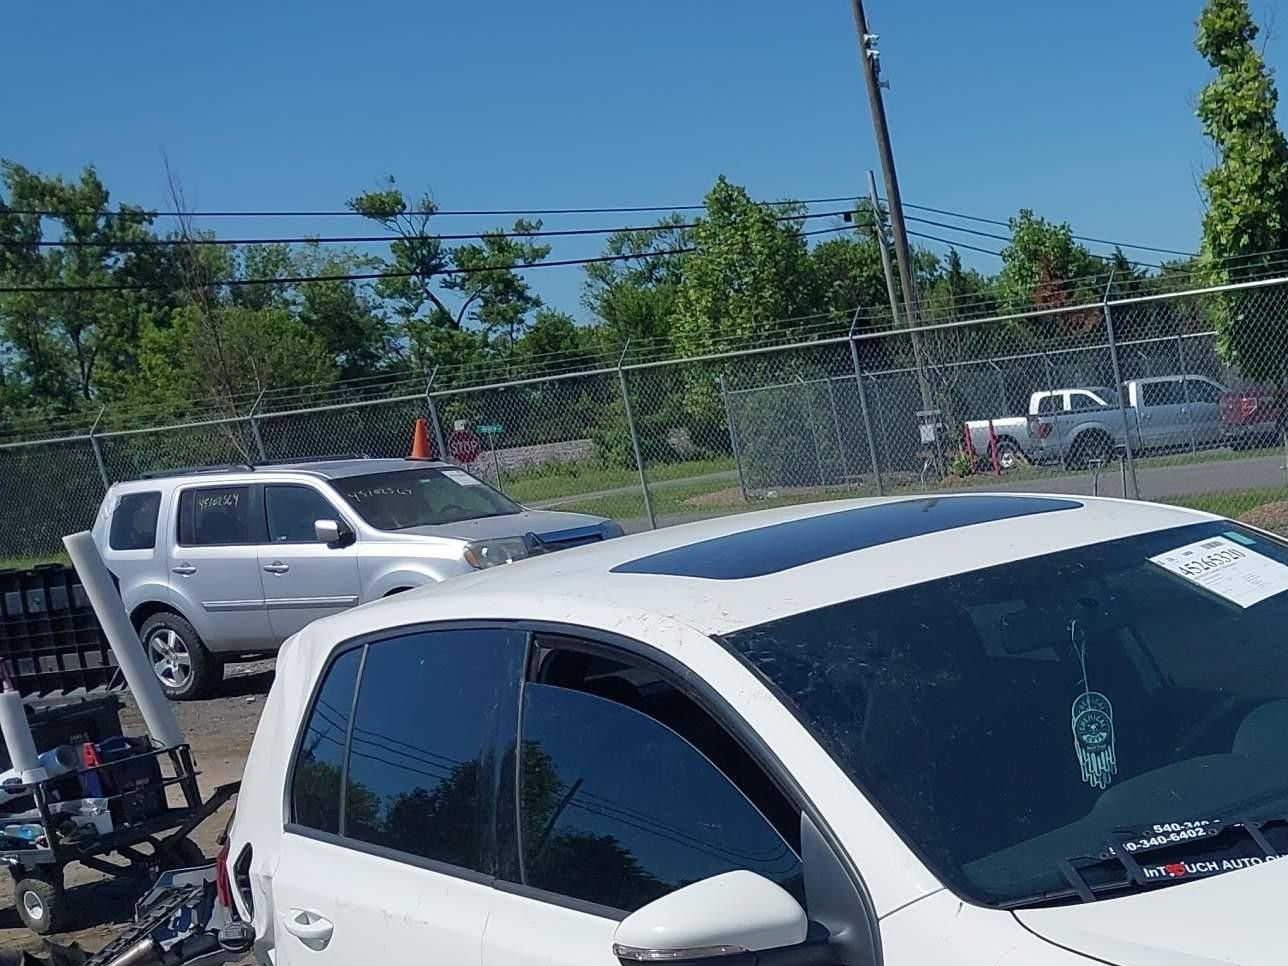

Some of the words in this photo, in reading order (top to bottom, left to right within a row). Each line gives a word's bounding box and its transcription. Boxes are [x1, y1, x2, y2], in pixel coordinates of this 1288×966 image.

[451, 440, 478, 453] STOP
[1178, 548, 1247, 576] 45265320
[1109, 827, 1207, 855] 0-340-6402
